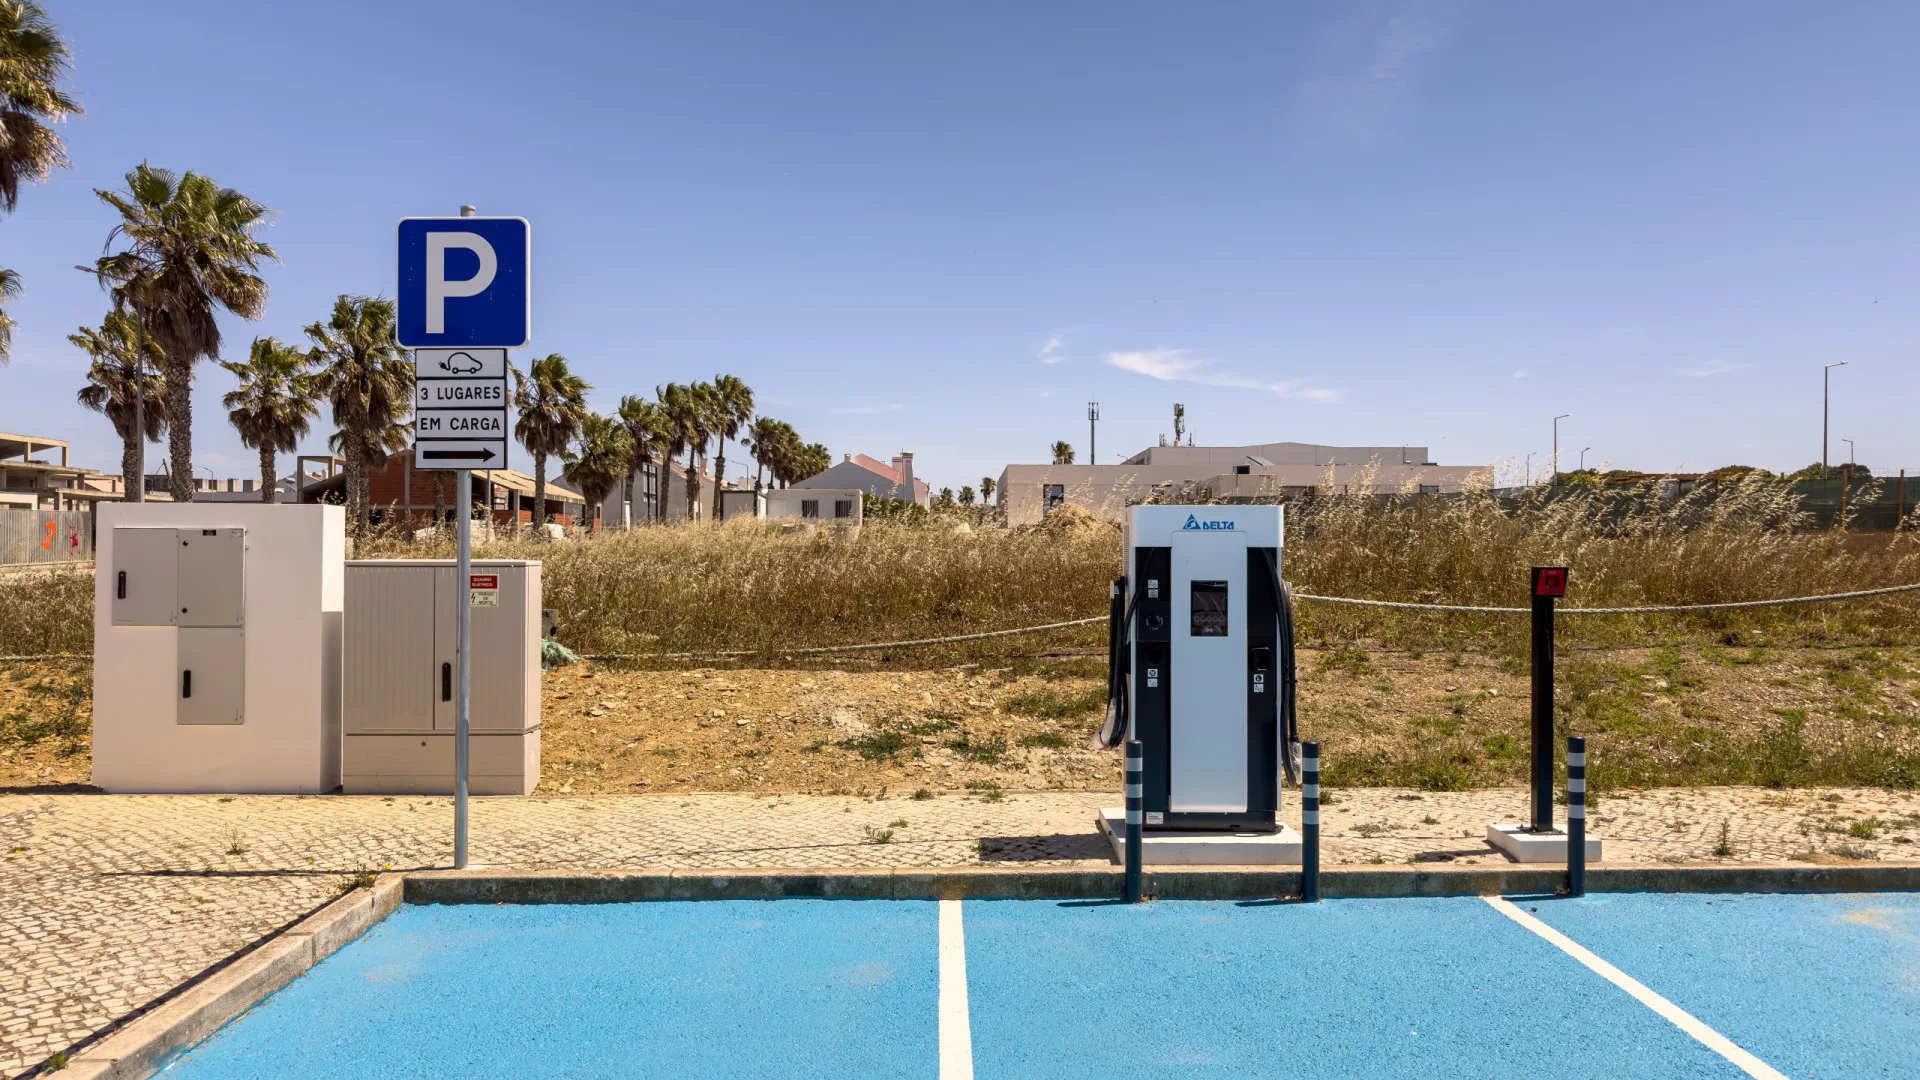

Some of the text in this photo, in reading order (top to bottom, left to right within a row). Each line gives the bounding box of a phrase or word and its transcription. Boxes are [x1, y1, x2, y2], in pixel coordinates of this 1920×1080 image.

[426, 232, 498, 334] P
[420, 386, 500, 400] 3 LUGARES
[420, 418, 500, 430] EM CARGA
[1203, 521, 1234, 530] DELTA
